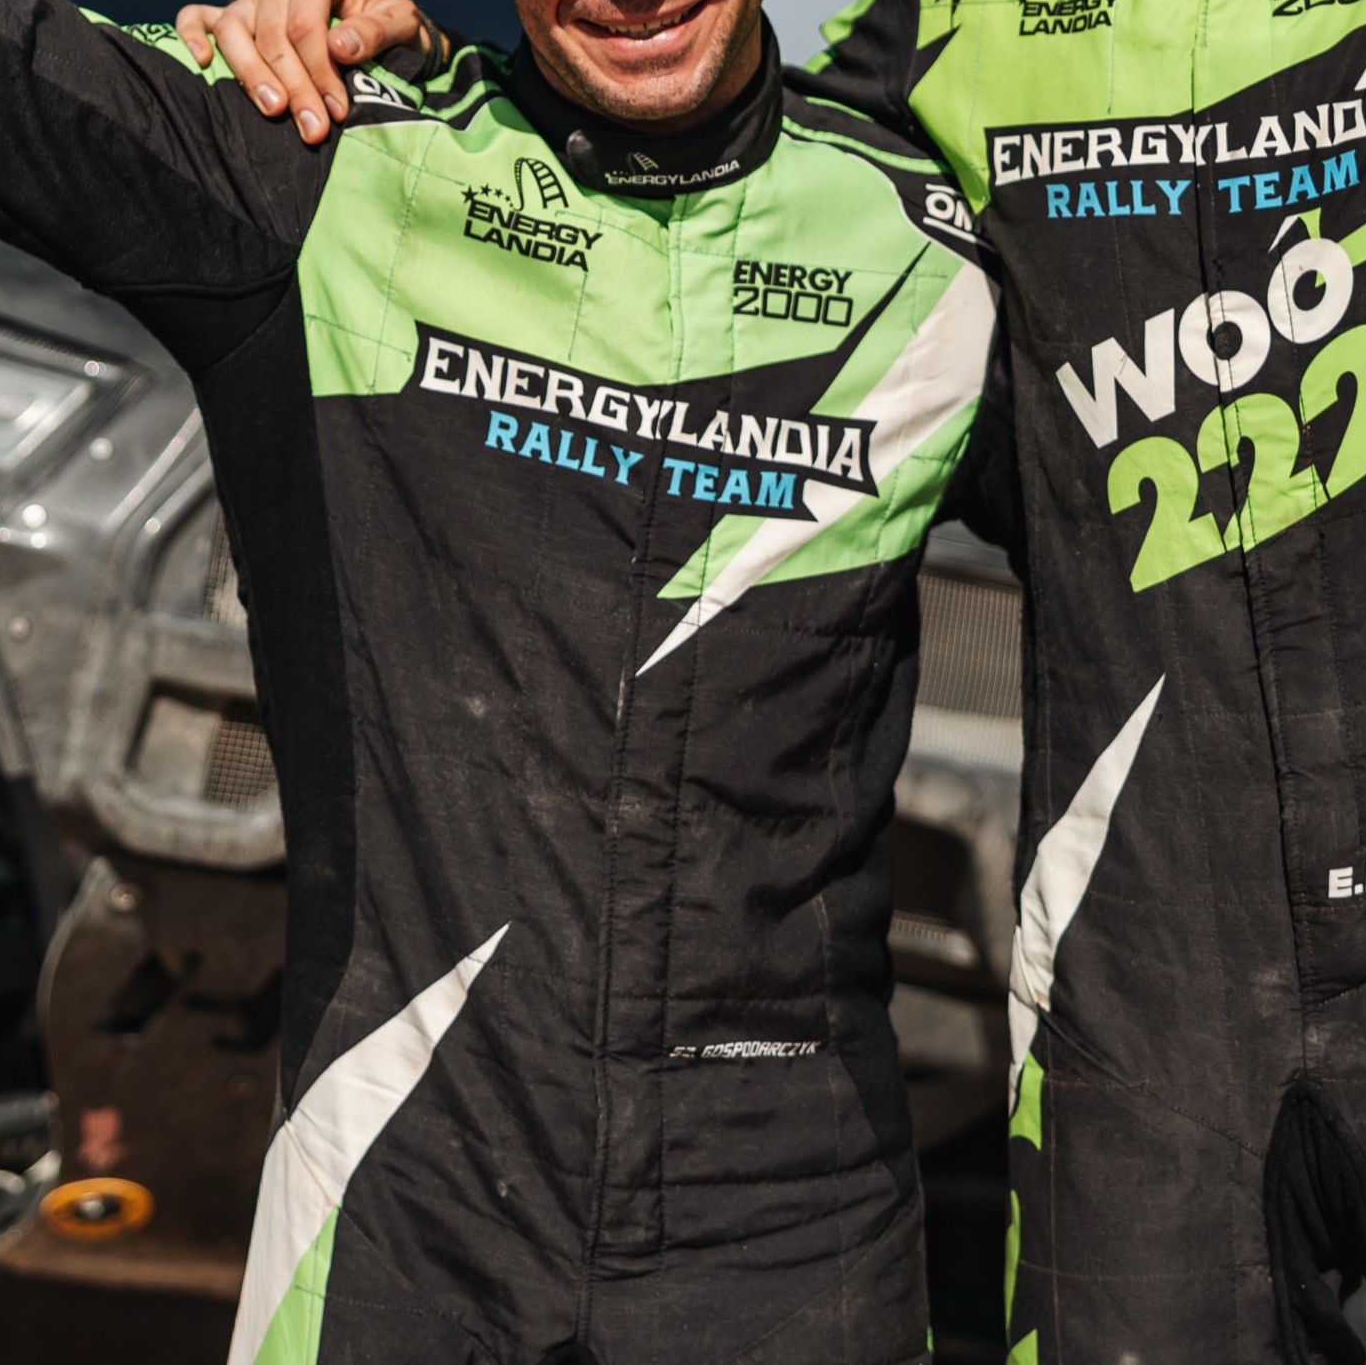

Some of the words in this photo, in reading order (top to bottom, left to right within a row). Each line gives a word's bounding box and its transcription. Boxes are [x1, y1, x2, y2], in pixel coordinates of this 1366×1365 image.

[1019, 10, 1113, 36] LANDIA
[607, 159, 741, 185] ENERGYLANDIA
[1045, 179, 1192, 219] RALLY
[1218, 149, 1359, 213] TEAM
[464, 219, 589, 273] LANDIA
[467, 199, 604, 251] ENERGY
[733, 260, 853, 295] ENERGY
[732, 286, 853, 327] 2000
[1055, 237, 1355, 450] WOO
[419, 336, 864, 483] ENERGYLANDIA
[485, 410, 644, 487] RALLY
[662, 457, 797, 511] TEAM
